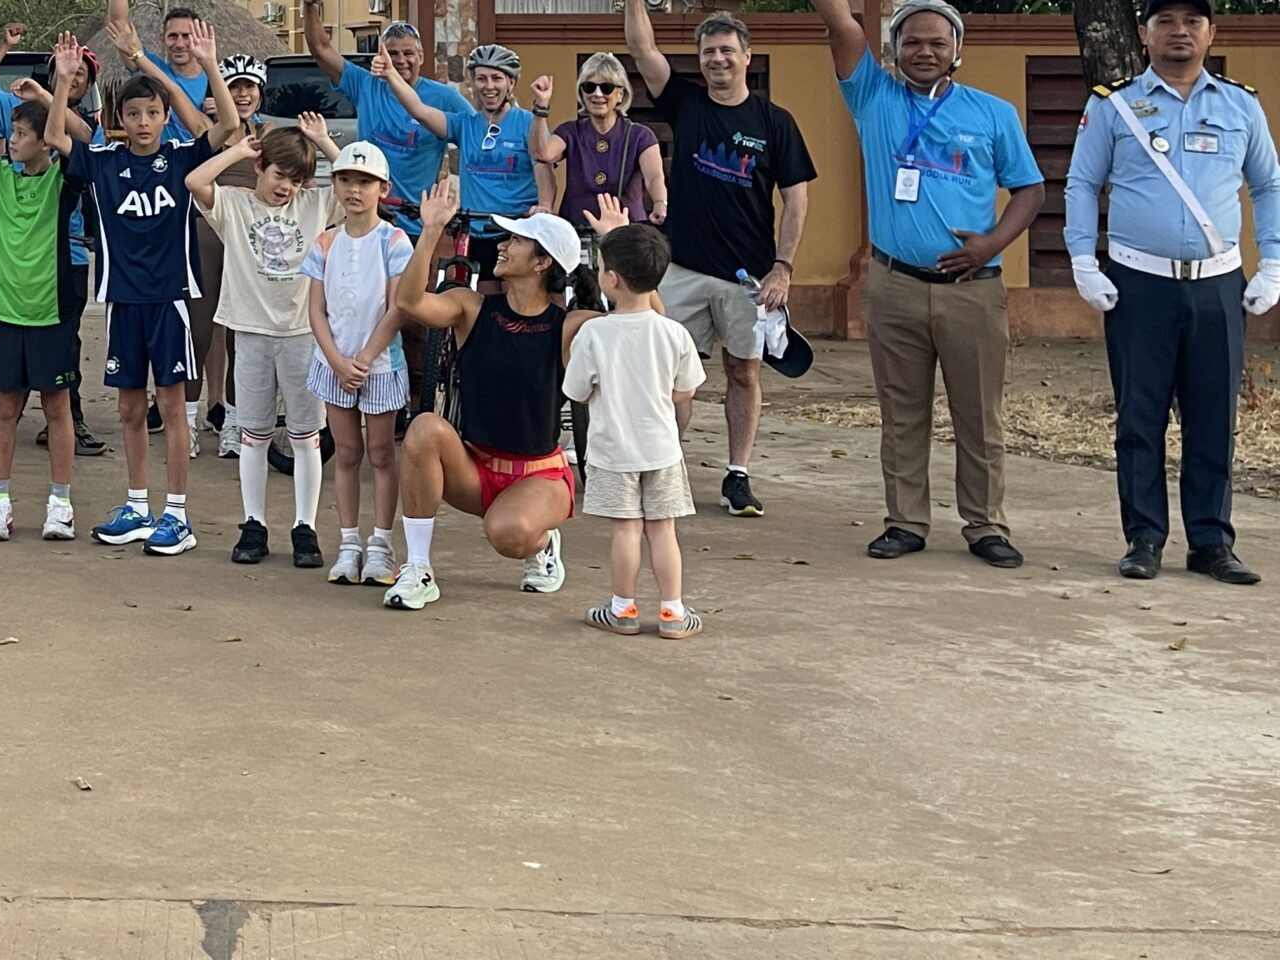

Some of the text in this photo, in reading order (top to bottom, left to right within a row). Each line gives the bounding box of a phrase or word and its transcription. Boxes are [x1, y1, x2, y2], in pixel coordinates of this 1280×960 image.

[920, 168, 972, 186] BODIA RUN
[117, 185, 176, 217] AIA
[273, 215, 298, 228] GOLF
[295, 228, 304, 253] CLUB
